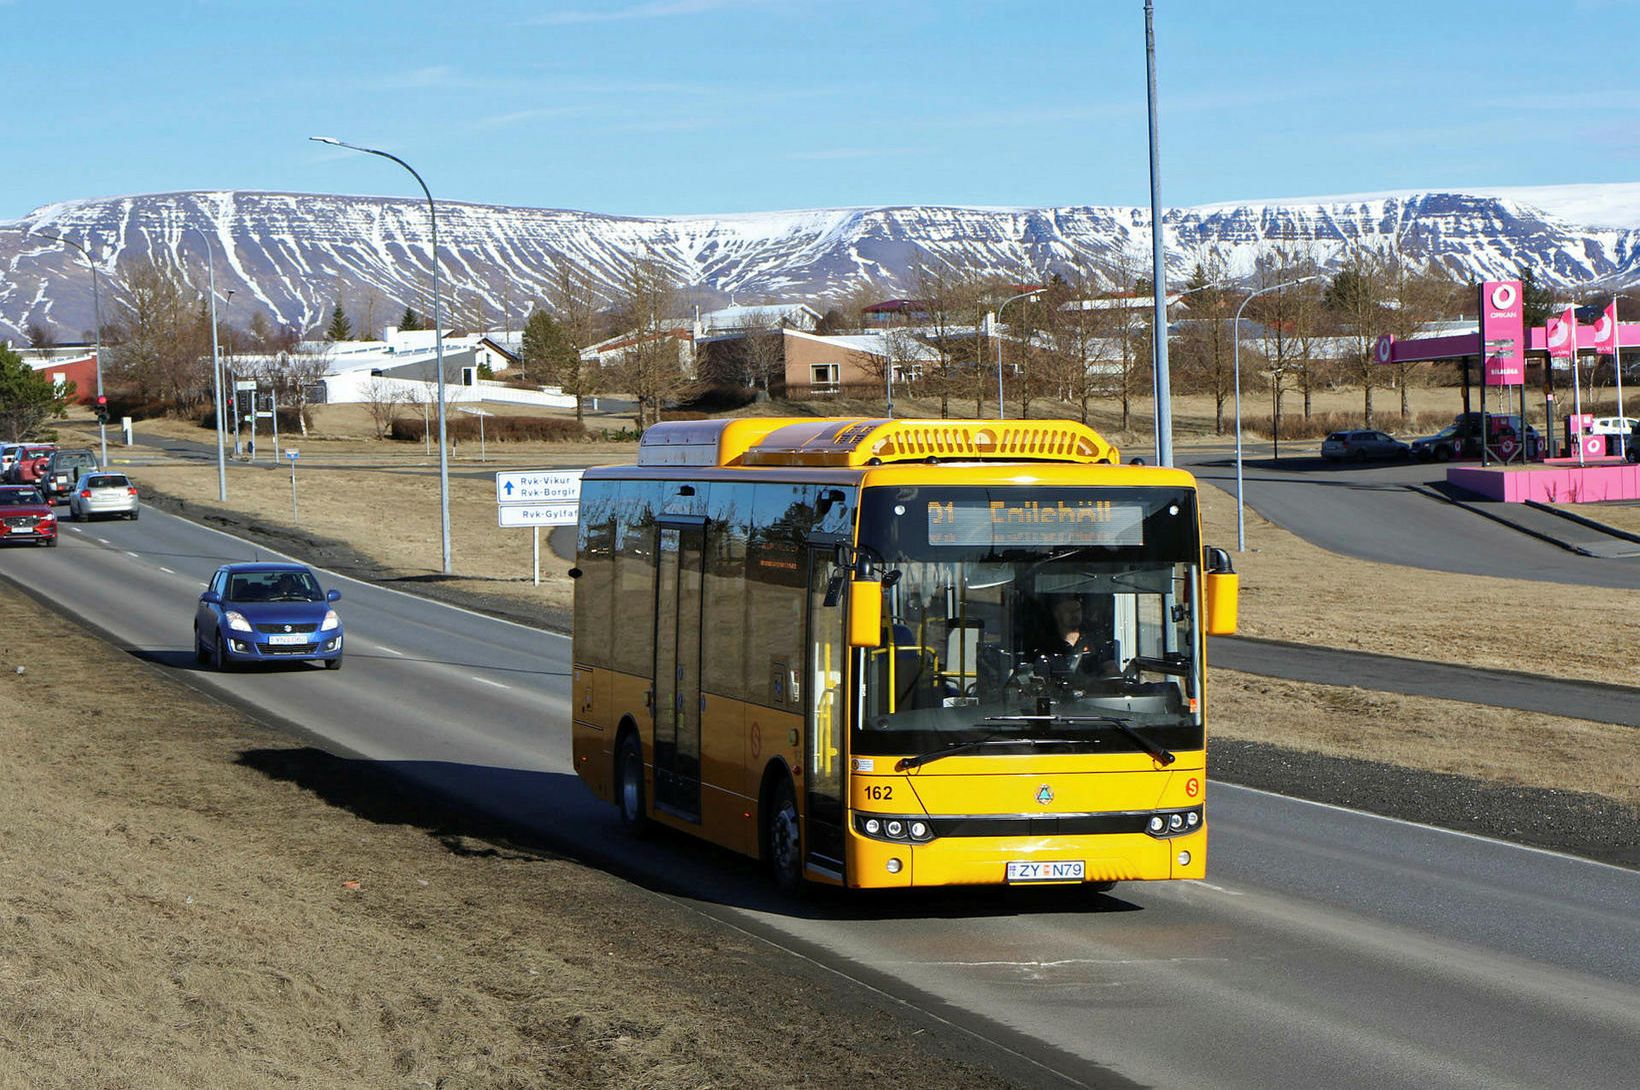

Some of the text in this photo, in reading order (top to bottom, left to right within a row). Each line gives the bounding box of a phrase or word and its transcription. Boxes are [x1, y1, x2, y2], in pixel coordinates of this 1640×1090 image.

[521, 488, 576, 497] Rvk-Borgir
[864, 785, 893, 800] 162
[1019, 863, 1082, 877] ZY N79
